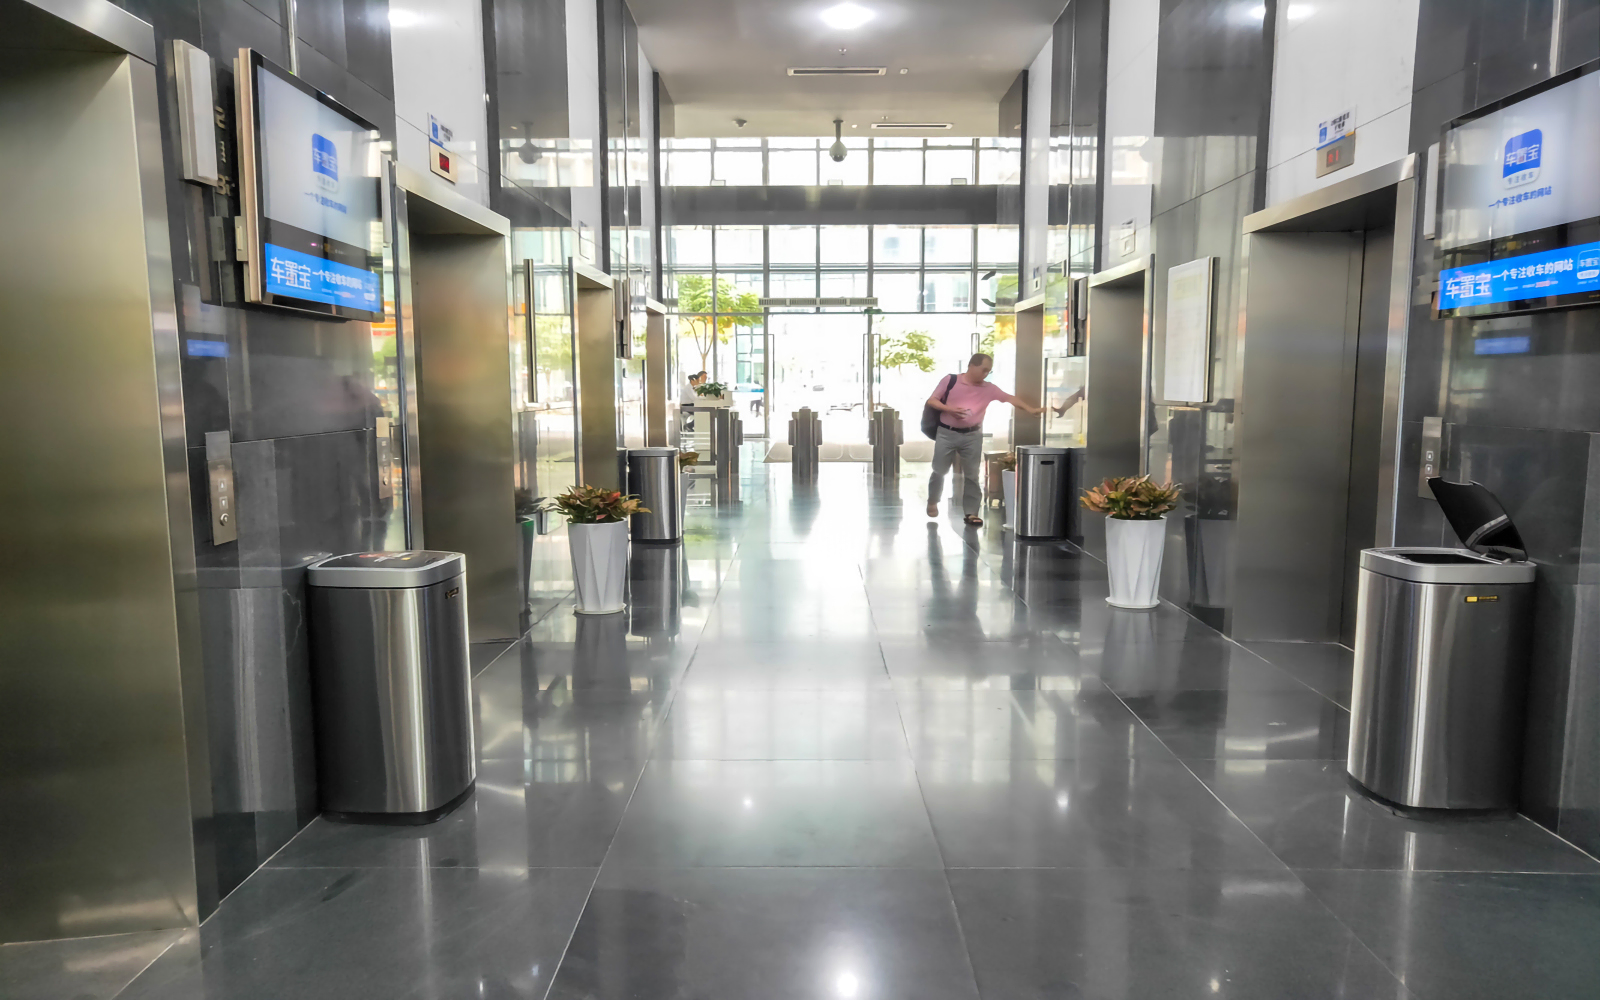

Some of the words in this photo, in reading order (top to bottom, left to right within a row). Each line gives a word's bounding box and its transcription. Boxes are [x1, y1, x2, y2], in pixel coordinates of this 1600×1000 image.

[1505, 144, 1540, 167] 车置宝
[1488, 186, 1552, 208] 一个专注收车的网站
[270, 257, 312, 290] 车置宝
[1445, 273, 1492, 299] 车置宝
[1492, 258, 1574, 281] 一个专注收车的网站
